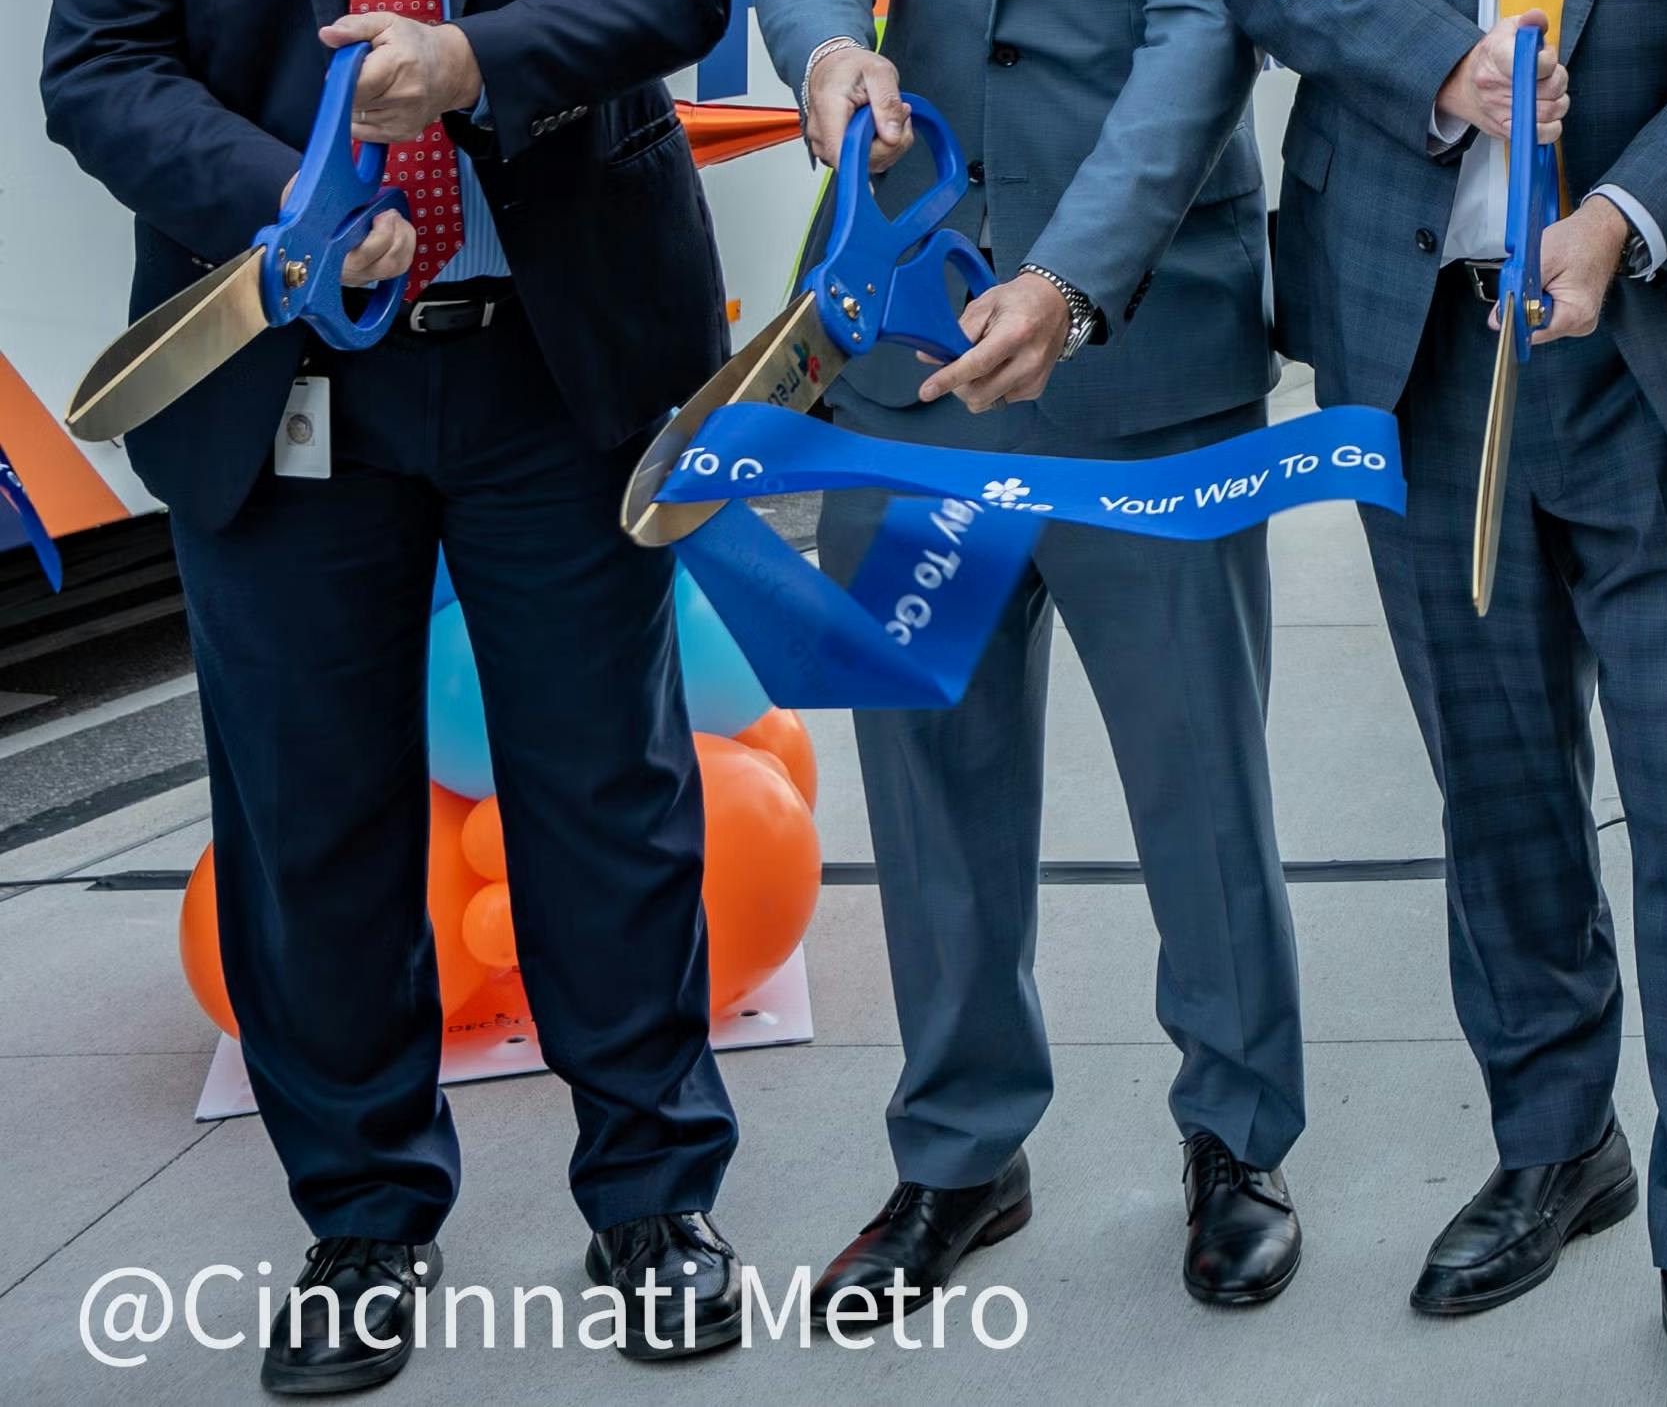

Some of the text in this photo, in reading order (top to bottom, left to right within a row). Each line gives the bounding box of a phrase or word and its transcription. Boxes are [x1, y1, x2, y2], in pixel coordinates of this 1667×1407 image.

[680, 447, 720, 476] To
[1099, 445, 1387, 515] Your Way To Go
[922, 549, 962, 589] To
